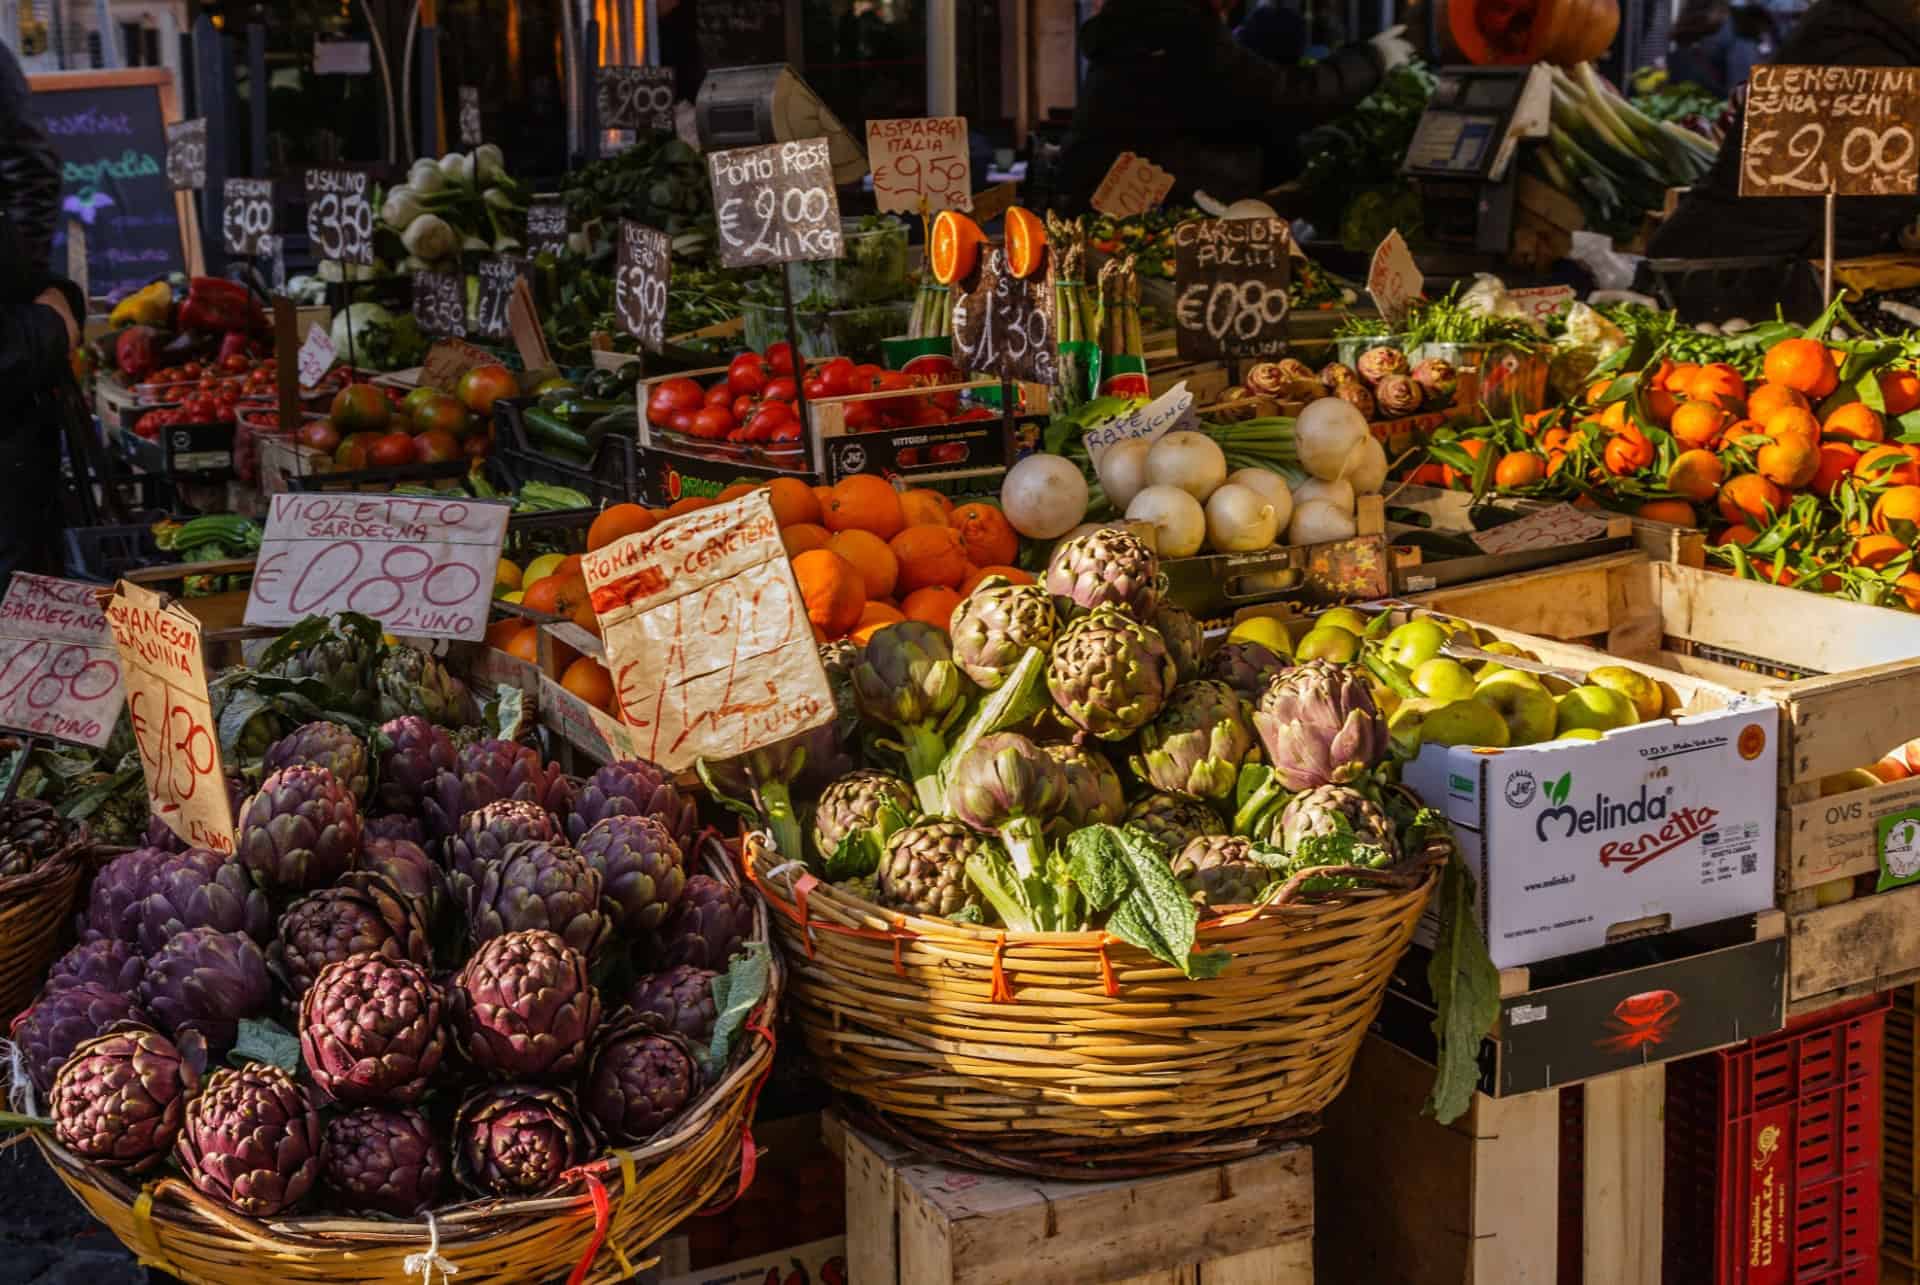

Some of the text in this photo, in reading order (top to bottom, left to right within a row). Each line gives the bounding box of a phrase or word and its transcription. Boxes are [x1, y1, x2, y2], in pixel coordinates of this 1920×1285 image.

[1752, 67, 1914, 93] CLEMENTINI
[1831, 94, 1892, 118] SEMI
[870, 119, 963, 141] ASPARAGI
[887, 138, 943, 152] ITALIA
[276, 494, 470, 526] VIOLETTO
[306, 521, 430, 542] SARDEGNA
[1, 601, 107, 633] SARDEGNA
[1536, 784, 1667, 843] Melinda
[1825, 802, 1862, 825] OVS
